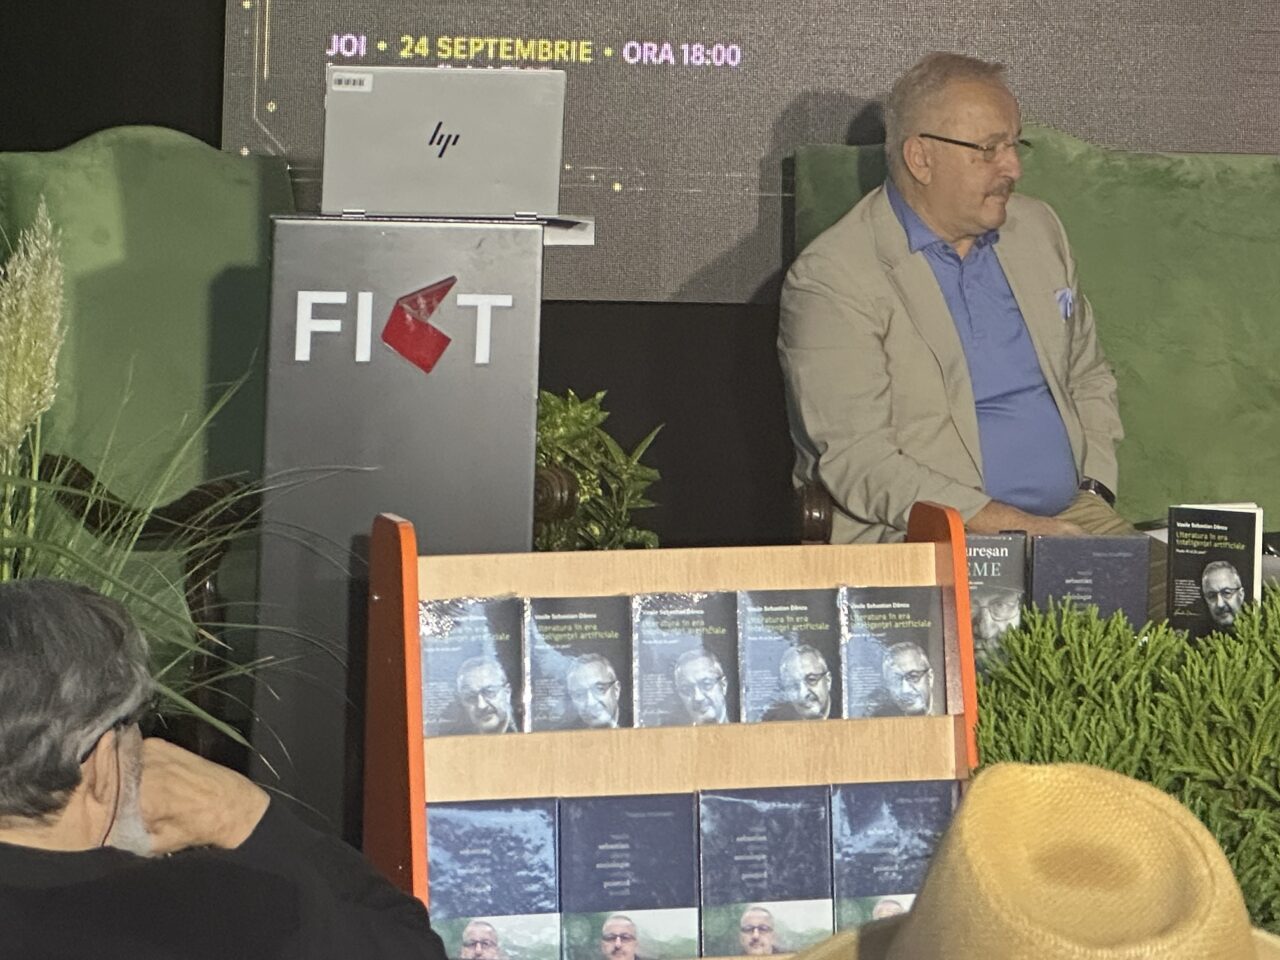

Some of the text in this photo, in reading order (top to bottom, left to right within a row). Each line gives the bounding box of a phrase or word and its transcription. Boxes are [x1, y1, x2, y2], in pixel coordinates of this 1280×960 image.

[326, 33, 742, 68] JOI 24 SEPTEMBRIE ORA 18:00
[428, 120, 460, 159] hp
[965, 546, 1009, 559] ureșan
